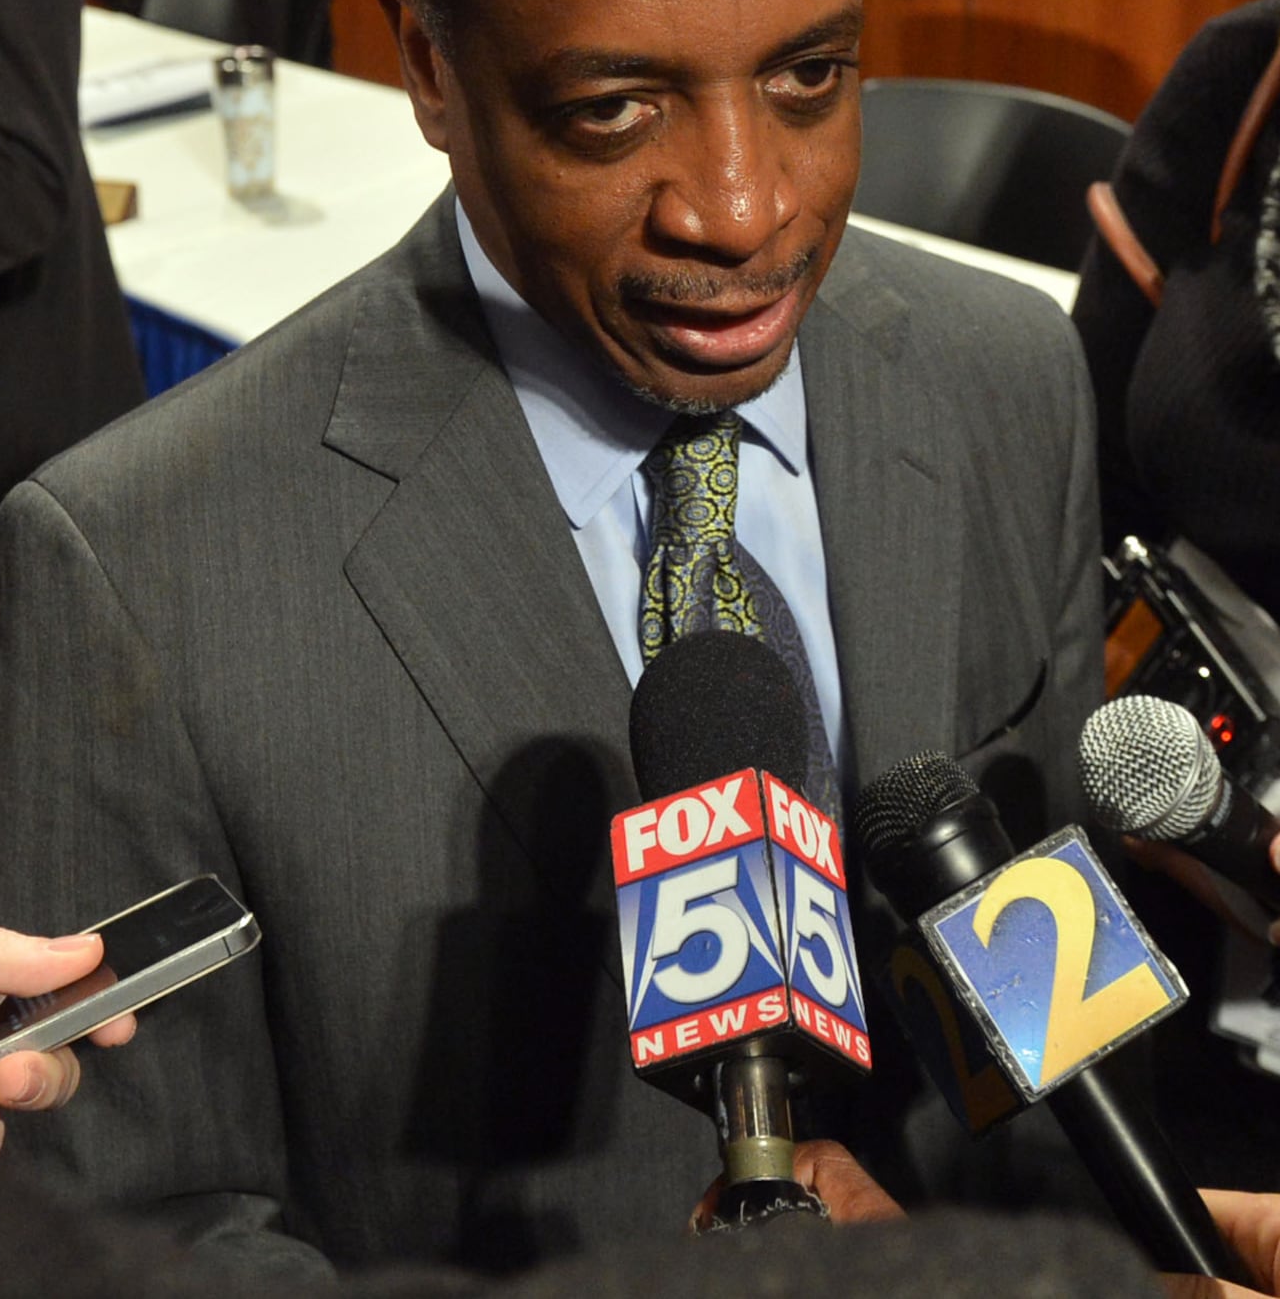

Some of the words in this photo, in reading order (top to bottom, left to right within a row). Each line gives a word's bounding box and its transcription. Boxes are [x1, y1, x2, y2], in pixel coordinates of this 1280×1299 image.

[622, 776, 752, 874] FOX
[769, 780, 840, 879] FOX
[651, 854, 751, 1004] 5
[794, 864, 849, 1008] 5
[972, 857, 1171, 1087] 2
[635, 994, 786, 1062] NEWS
[793, 995, 870, 1062] NEWS
